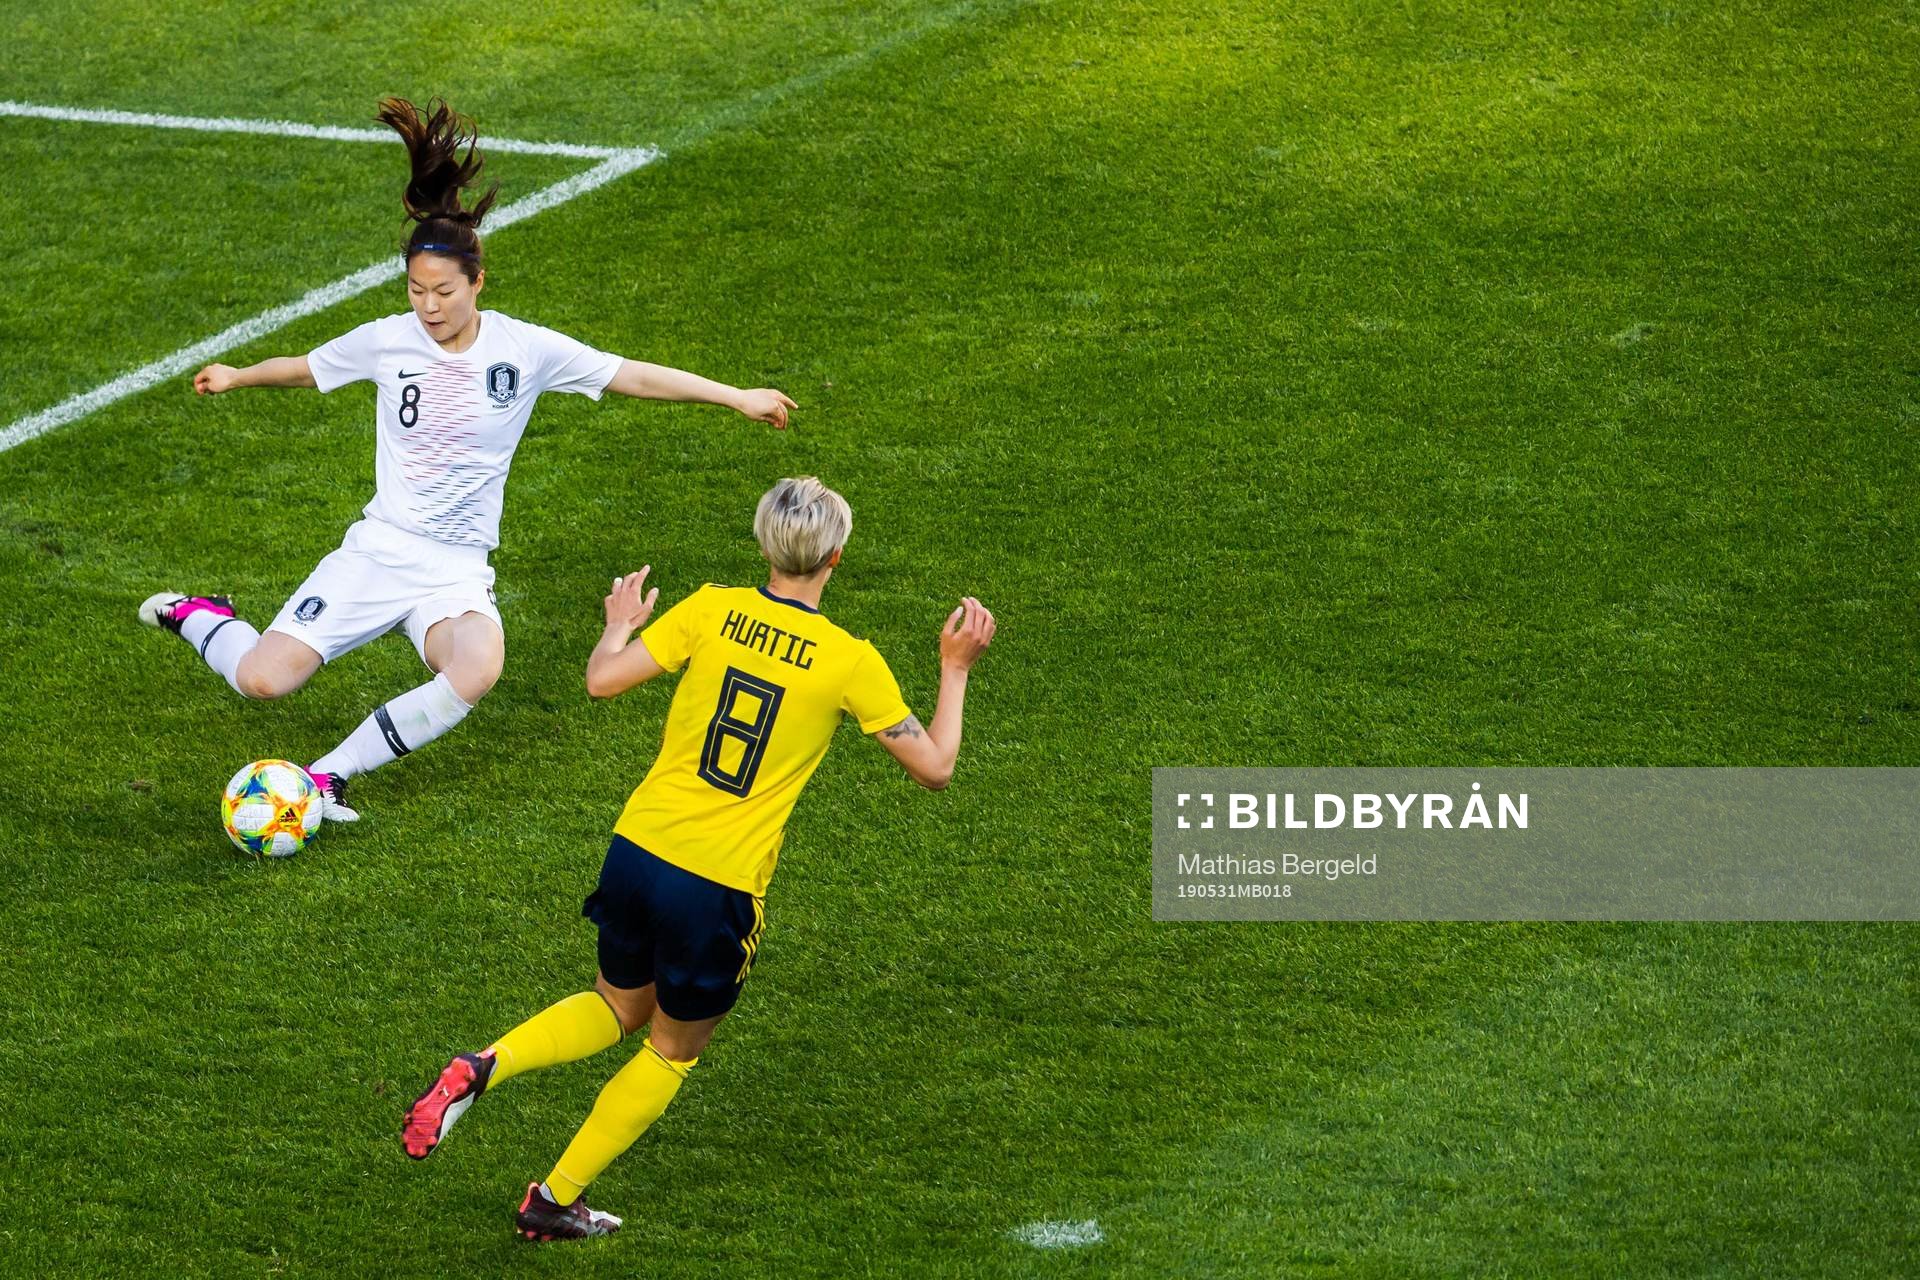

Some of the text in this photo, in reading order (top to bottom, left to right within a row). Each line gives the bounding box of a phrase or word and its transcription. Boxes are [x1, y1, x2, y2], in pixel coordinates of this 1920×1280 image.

[399, 384, 421, 428] 8
[720, 609, 817, 671] HURTIG
[697, 665, 786, 799] 8
